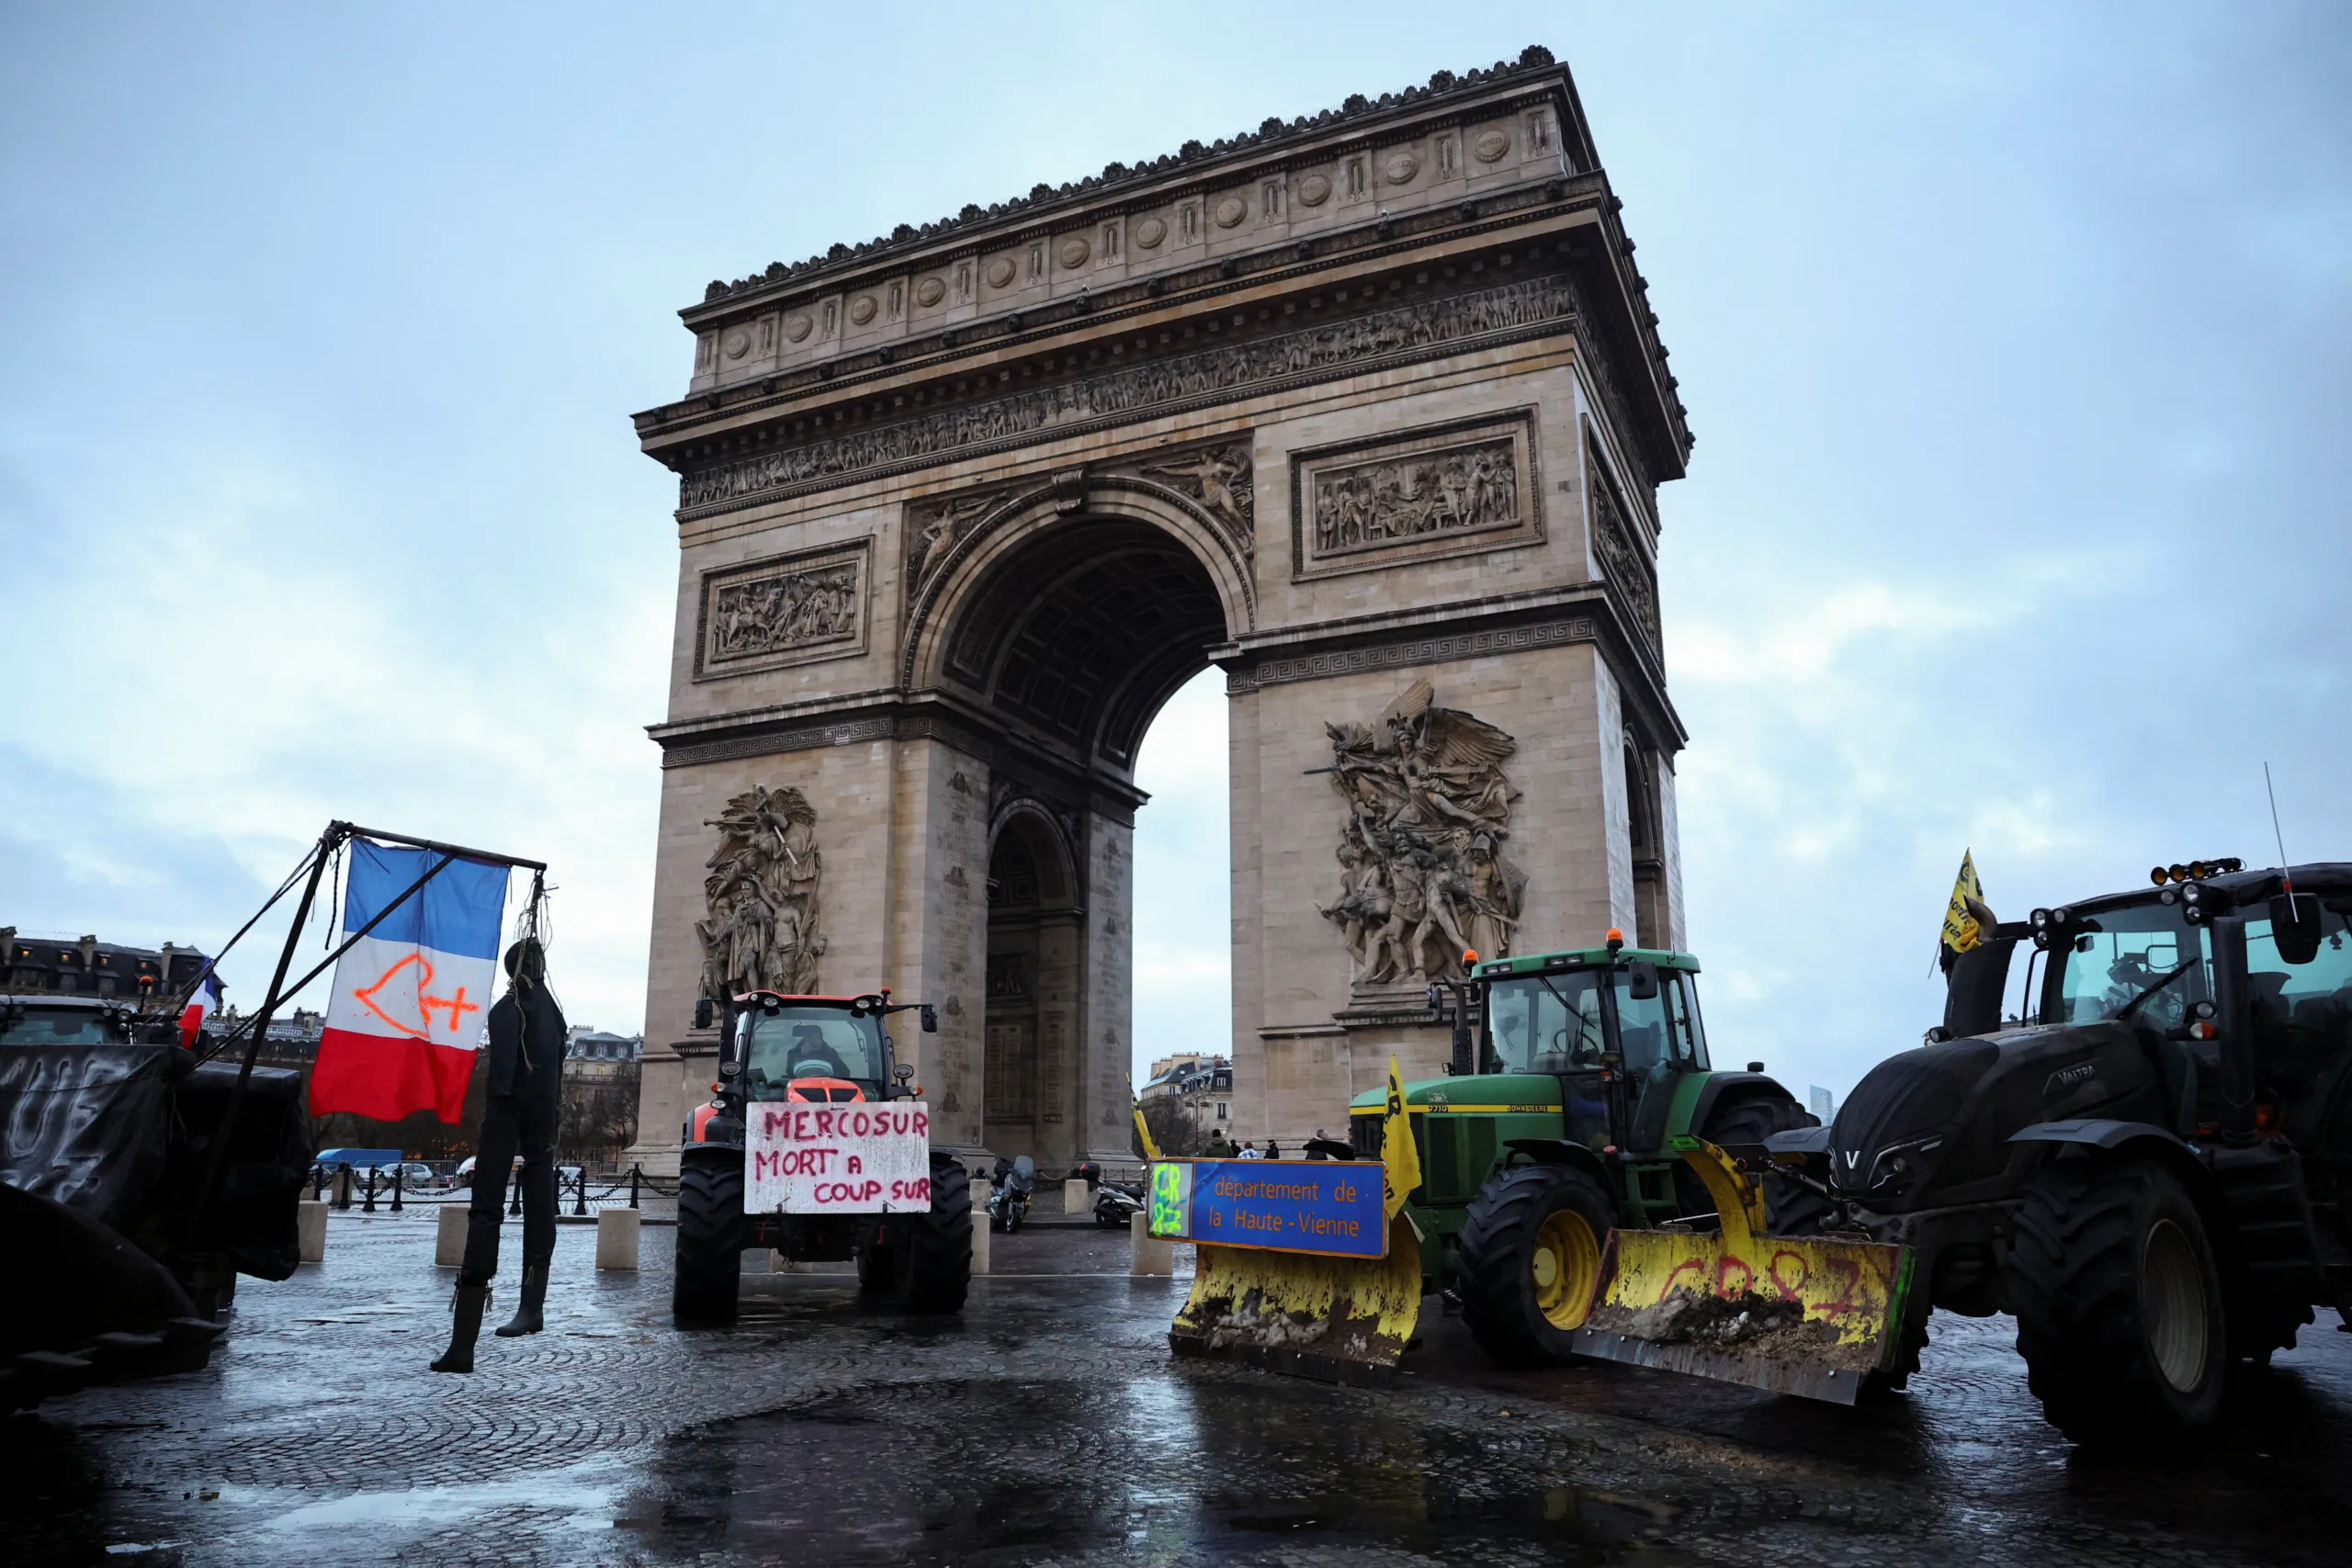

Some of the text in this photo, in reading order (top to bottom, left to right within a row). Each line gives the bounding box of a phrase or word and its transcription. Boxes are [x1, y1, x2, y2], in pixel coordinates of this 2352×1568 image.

[2057, 1065, 2095, 1086] VALTRA
[765, 1111, 929, 1142] MERCOSUR
[755, 1149, 862, 1181] MORT A
[814, 1178, 931, 1203] COUP SUR
[1154, 1163, 1181, 1201] CR
[1214, 1176, 1357, 1202] département de
[1208, 1205, 1222, 1227] la
